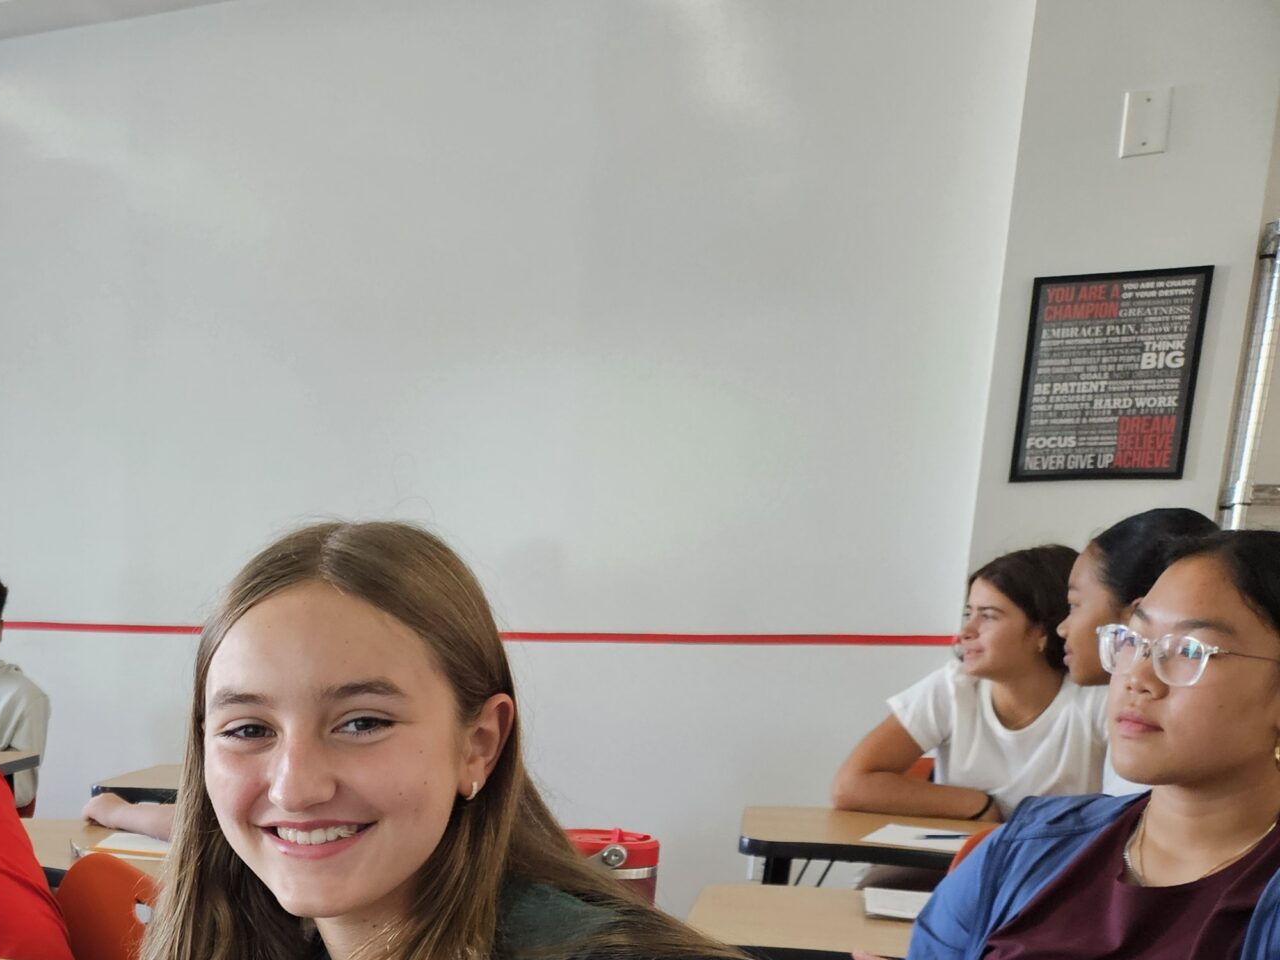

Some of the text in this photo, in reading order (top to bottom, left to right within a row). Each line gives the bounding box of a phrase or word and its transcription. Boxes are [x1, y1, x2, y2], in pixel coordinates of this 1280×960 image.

[1166, 279, 1196, 287] CHARGE
[1047, 283, 1120, 303] YOU ARE A
[1044, 302, 1118, 321] CHAMPION
[1041, 326, 1104, 339] EMBRACE
[1143, 341, 1186, 351] THINK
[1141, 351, 1185, 369] BIG
[1080, 372, 1109, 380] GOALS
[1033, 381, 1107, 395] BE PATIENT
[1049, 394, 1093, 403] EXCUSES
[1093, 395, 1179, 409] HARD WORK
[1118, 415, 1176, 433] DREAM
[1026, 436, 1076, 449] FOCUS
[1117, 434, 1173, 450] BELIEVE
[1024, 453, 1114, 470] NEVER GIVE UP
[1113, 450, 1171, 468] ACHIEVE
